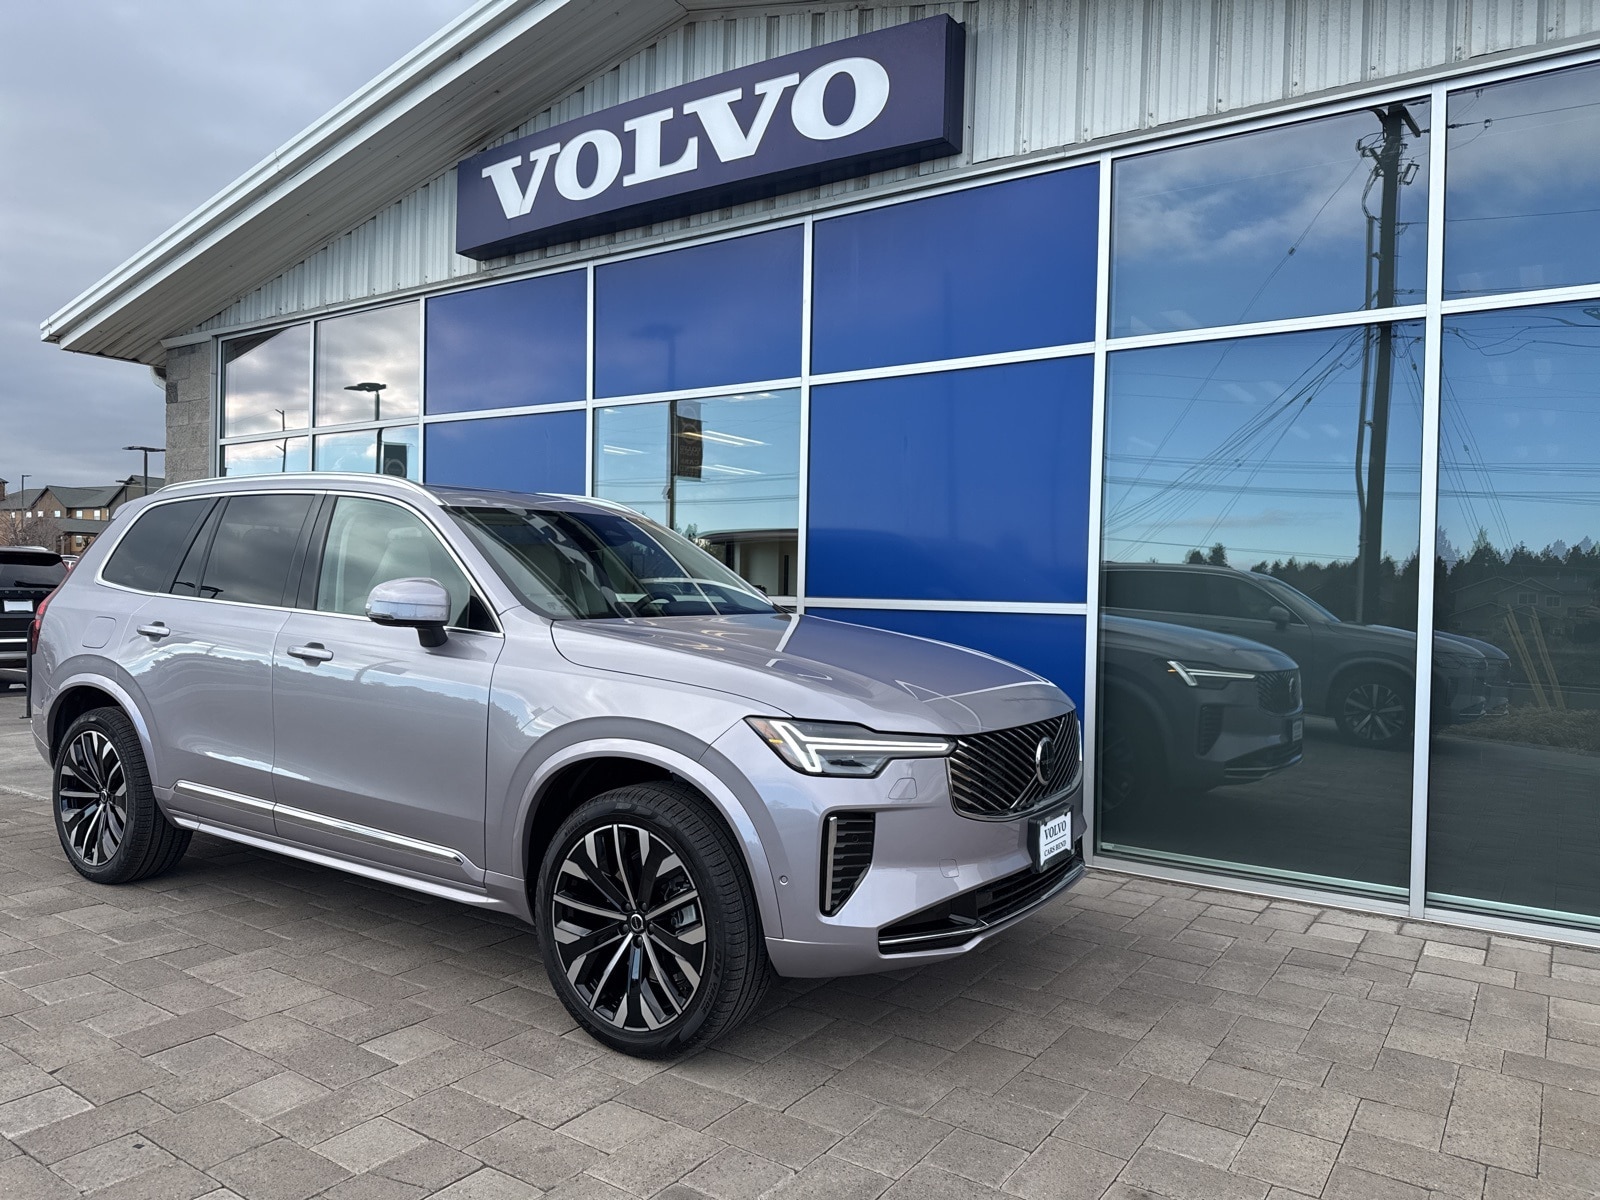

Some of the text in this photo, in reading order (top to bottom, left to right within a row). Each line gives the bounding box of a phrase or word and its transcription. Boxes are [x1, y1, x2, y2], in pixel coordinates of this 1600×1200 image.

[481, 57, 890, 220] VOLVO
[1044, 820, 1067, 840] VOLVO
[1044, 840, 1067, 857] CARS BEND
